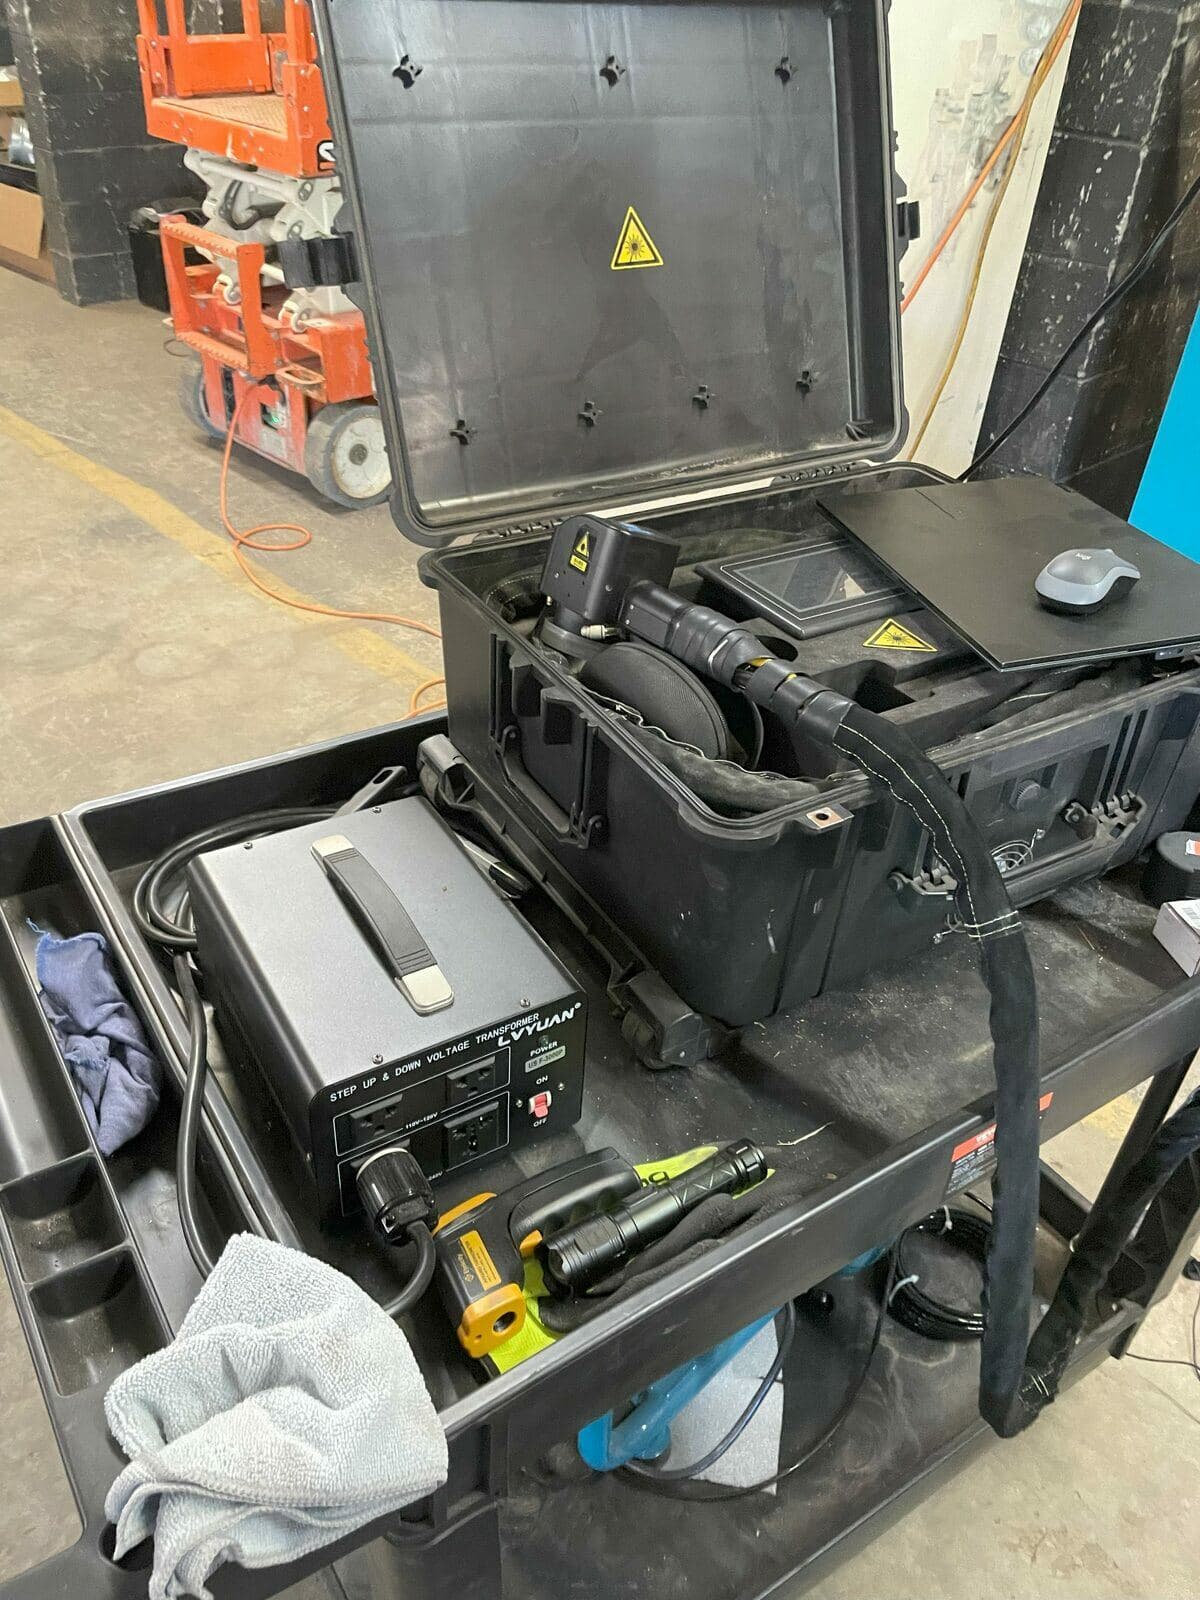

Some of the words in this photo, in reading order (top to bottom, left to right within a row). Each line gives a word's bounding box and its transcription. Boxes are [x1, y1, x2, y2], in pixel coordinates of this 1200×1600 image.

[530, 1041, 558, 1056] POWER
[330, 1085, 357, 1102] STEP
[362, 1077, 377, 1089] UP
[382, 1072, 390, 1081] &
[395, 1059, 421, 1076] DOWN
[426, 1040, 470, 1064] VOLTAGE
[476, 1013, 539, 1044] TRANSFORMER
[536, 1075, 548, 1085] ON
[533, 1118, 547, 1128] OFF
